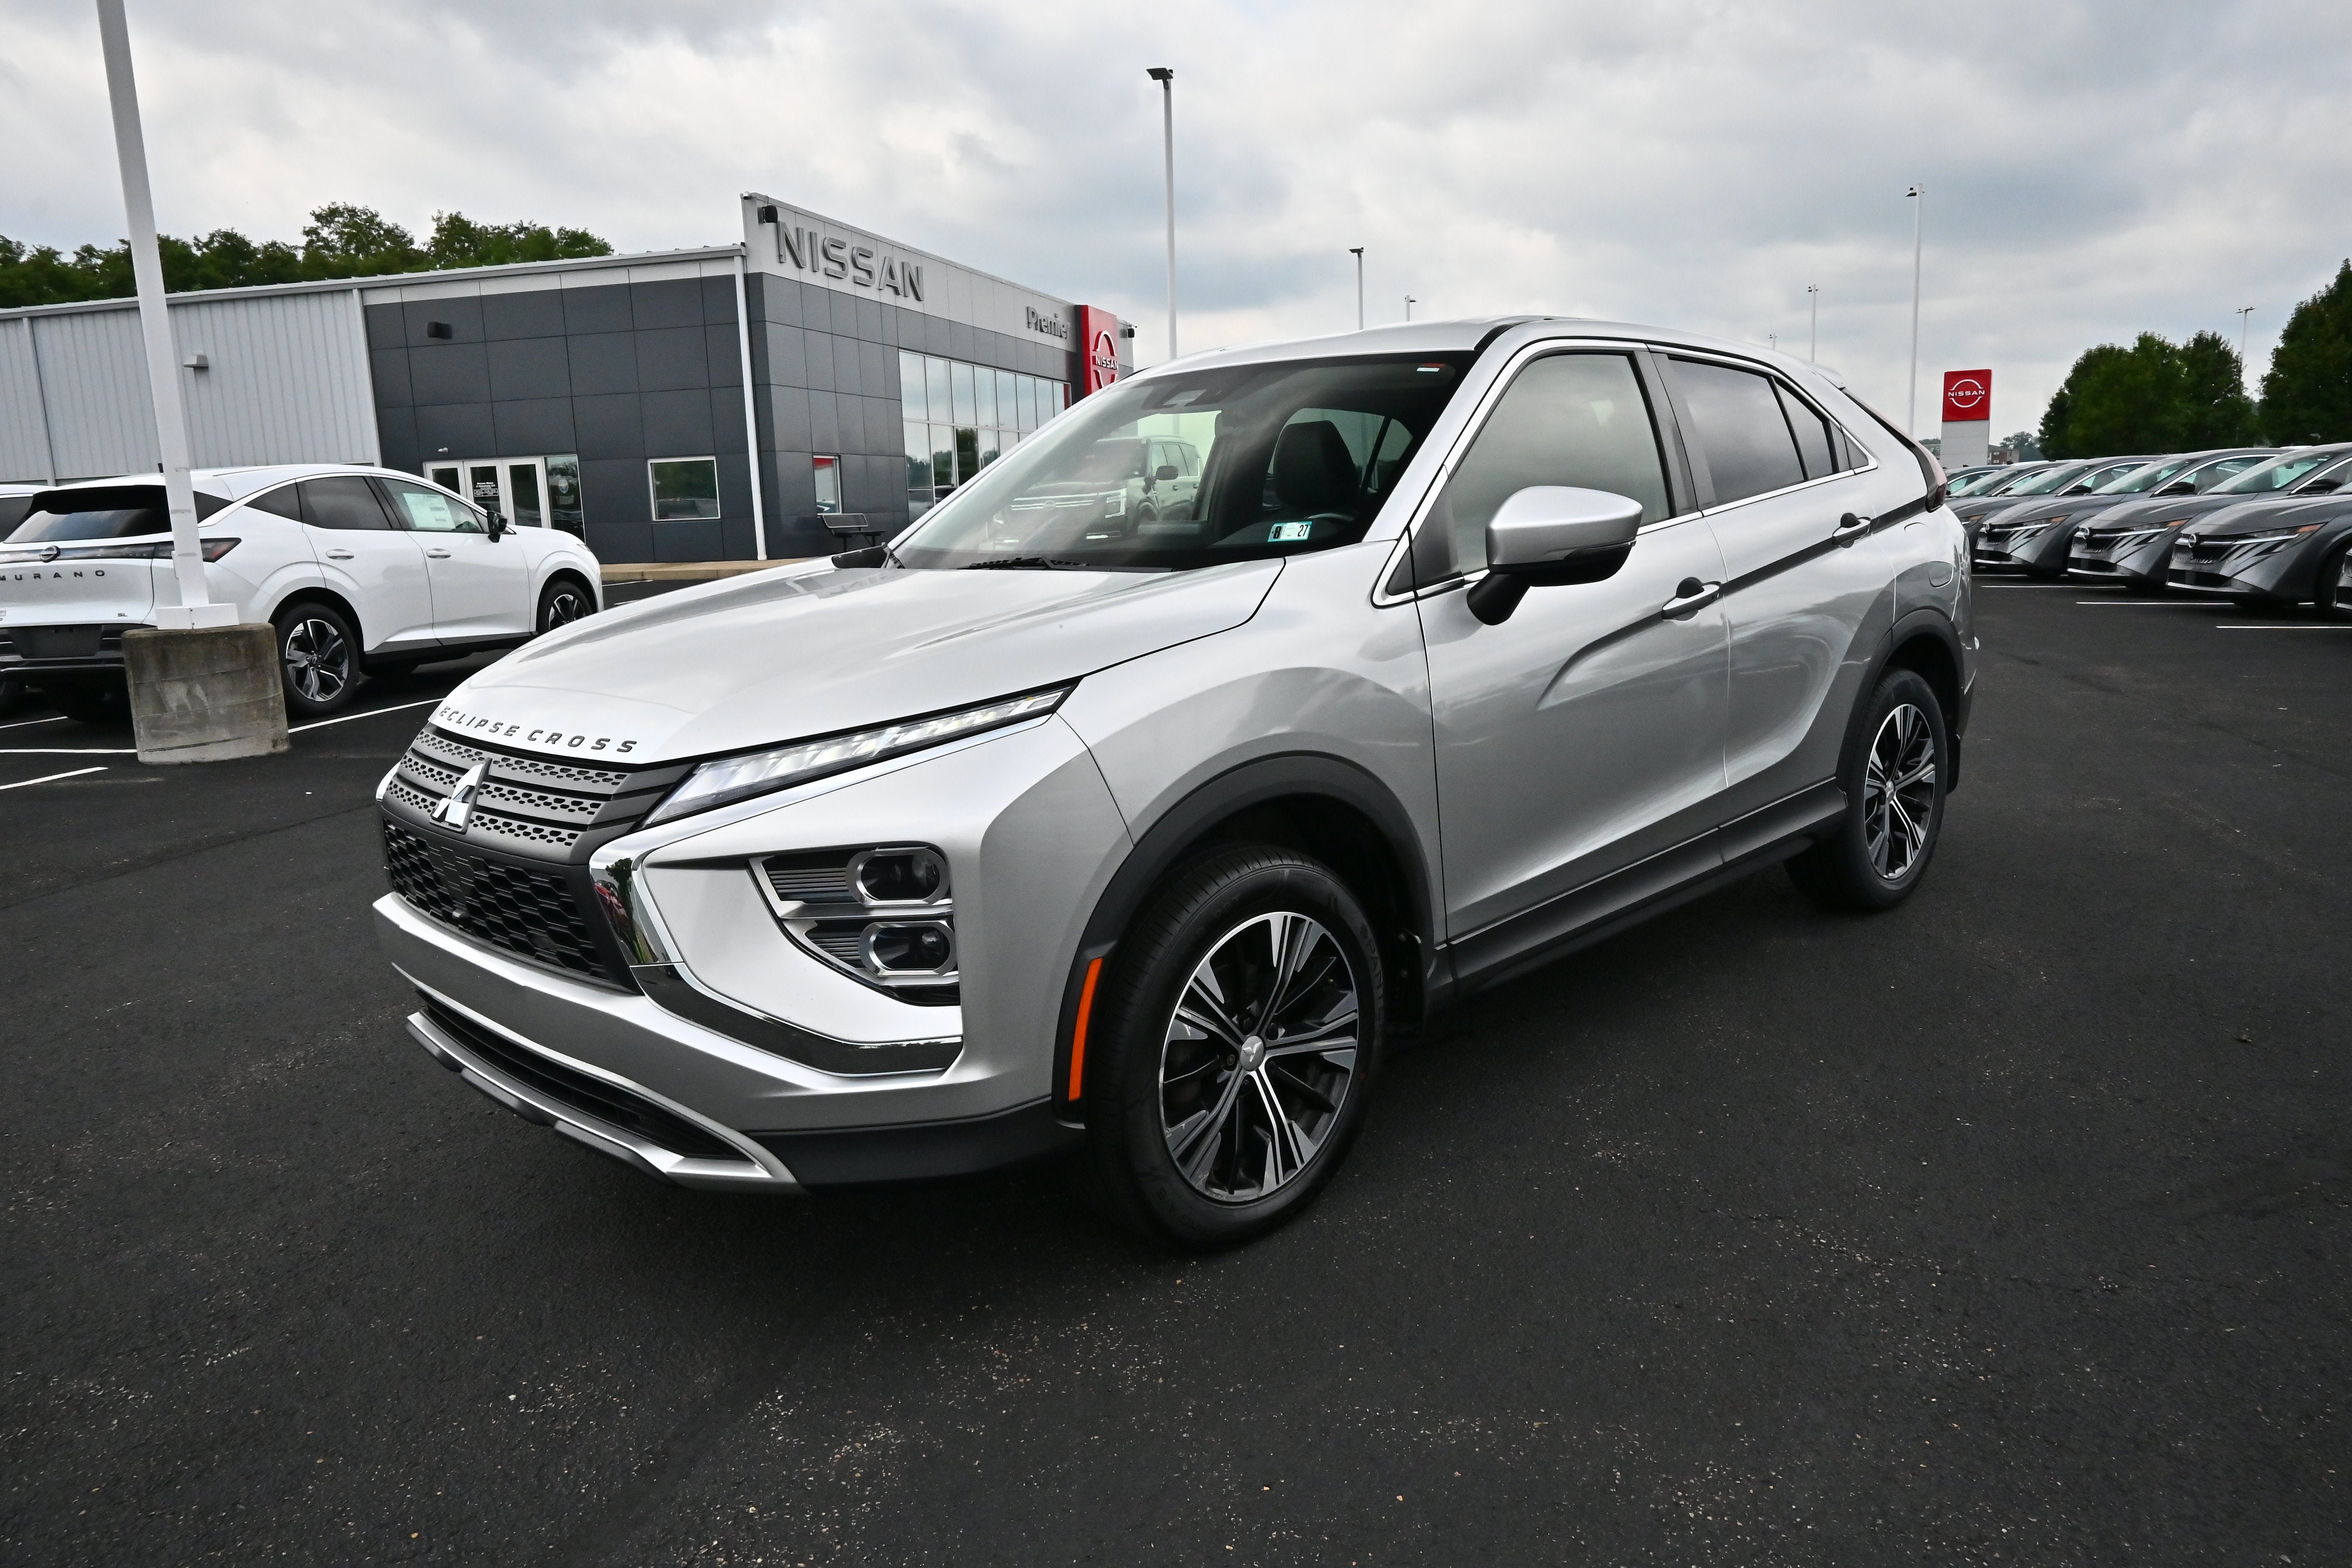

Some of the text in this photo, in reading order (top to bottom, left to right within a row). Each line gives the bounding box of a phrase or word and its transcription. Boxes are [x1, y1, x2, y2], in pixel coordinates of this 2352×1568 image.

[776, 220, 924, 302] NISSAN
[1026, 306, 1070, 339] Premier
[1095, 355, 1118, 370] NISSAN
[1273, 526, 1282, 539] 8
[1297, 524, 1309, 537] 27
[438, 706, 637, 753] ECLIPSE CROSS
